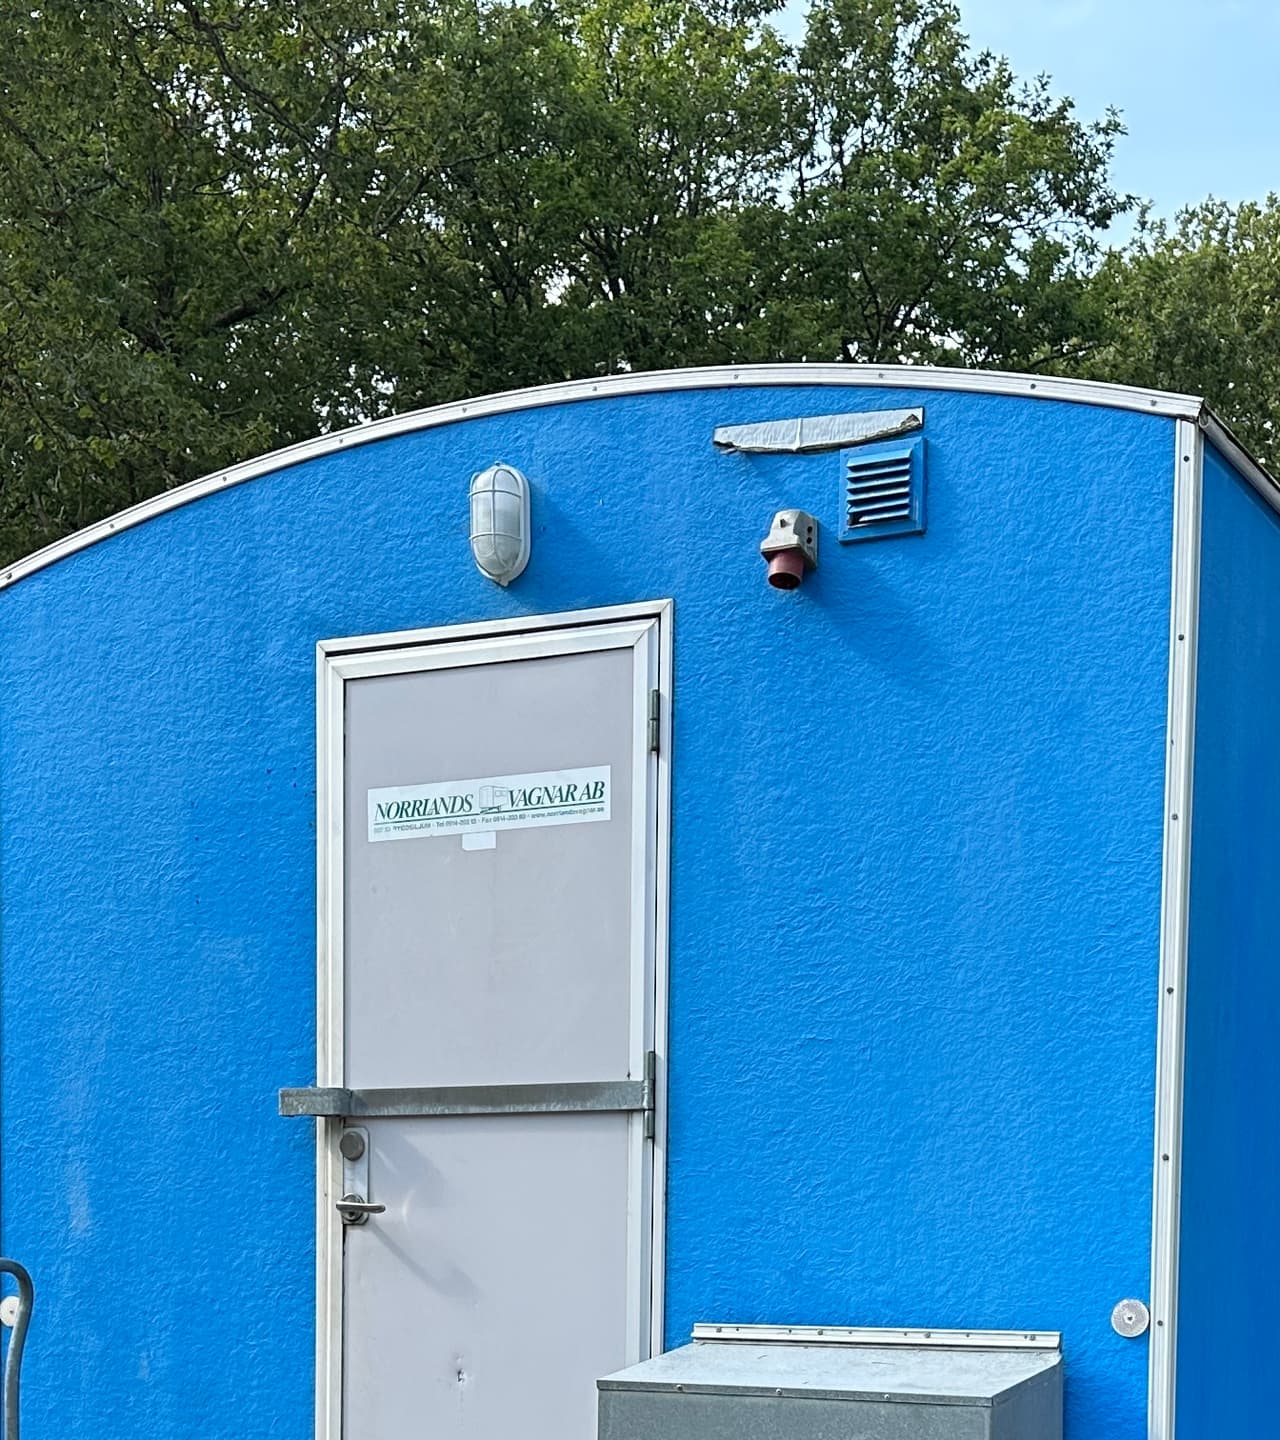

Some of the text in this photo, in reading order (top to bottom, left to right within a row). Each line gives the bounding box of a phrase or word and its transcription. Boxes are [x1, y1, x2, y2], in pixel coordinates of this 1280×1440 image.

[375, 781, 605, 821] NORRLANDS VAGNAR AB
